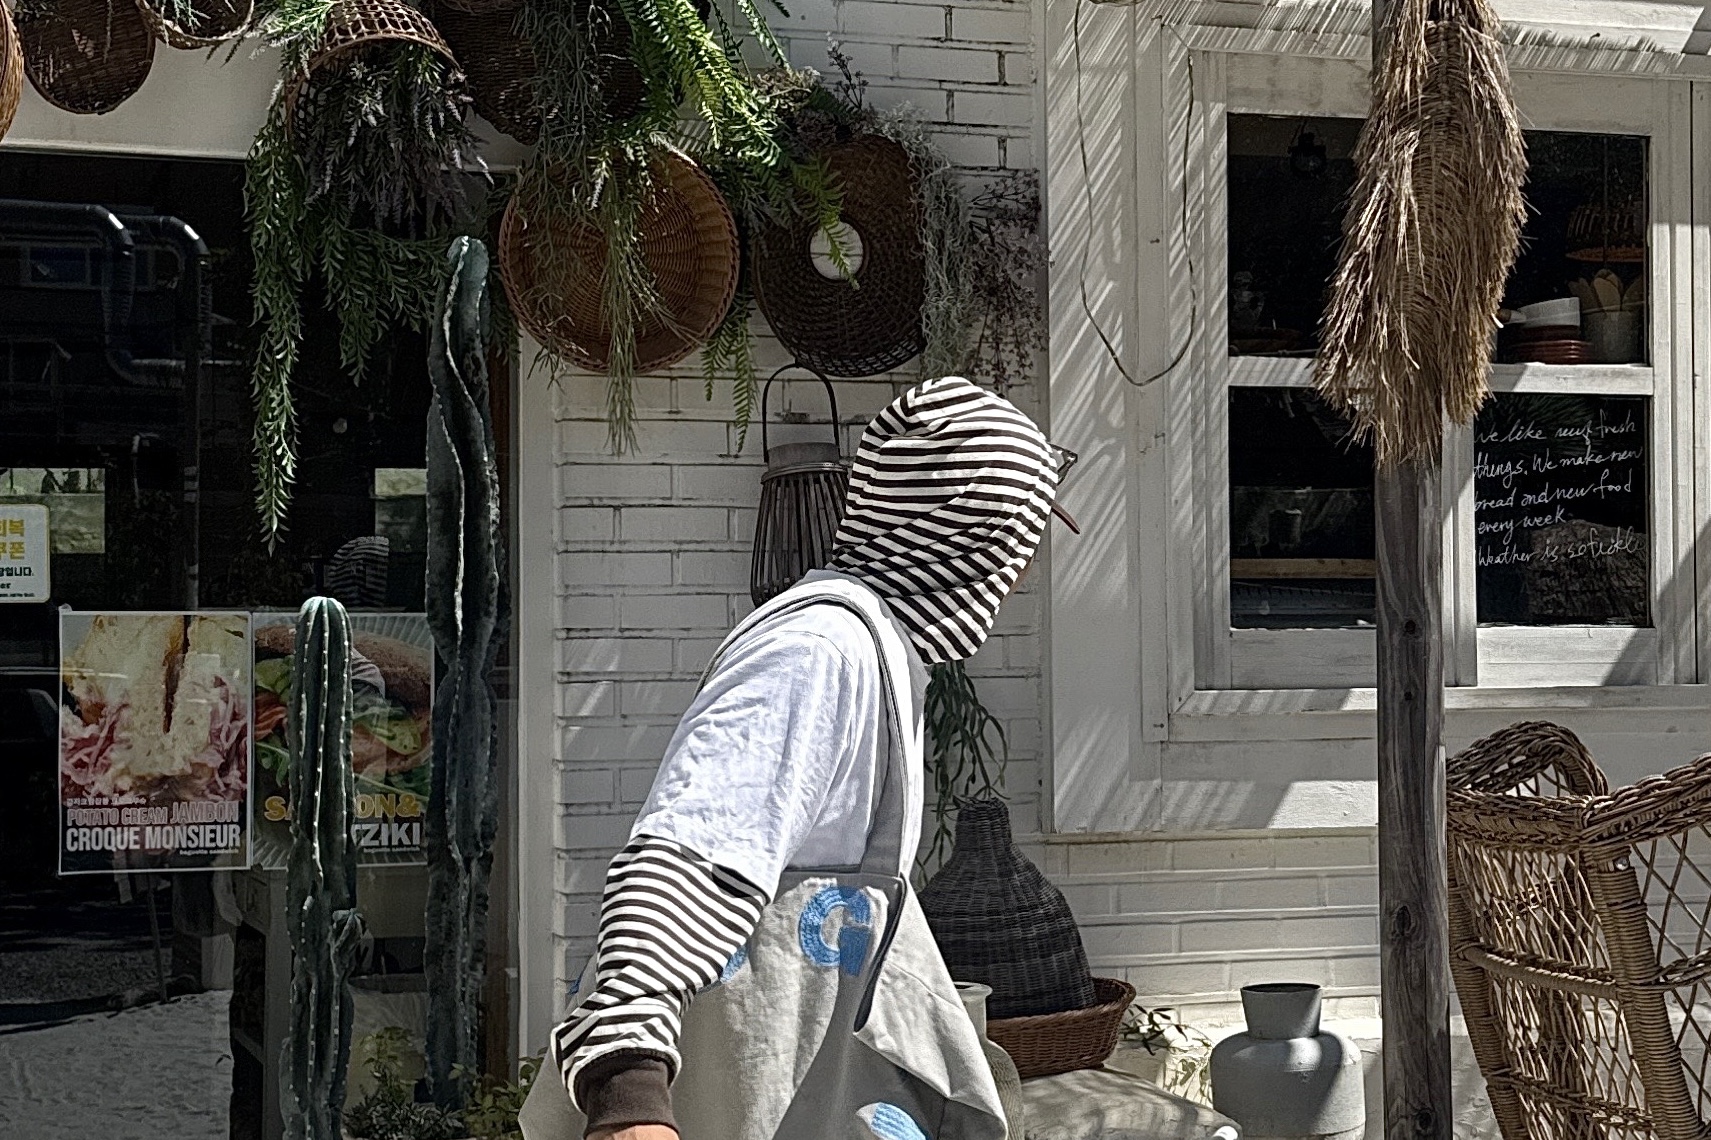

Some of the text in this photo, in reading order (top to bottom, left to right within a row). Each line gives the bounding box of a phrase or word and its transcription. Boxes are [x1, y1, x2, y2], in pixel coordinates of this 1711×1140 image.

[1500, 419, 1547, 442] like
[1595, 408, 1637, 439] fresh
[1533, 447, 1558, 473] We
[1560, 444, 1606, 466] make
[1474, 468, 1632, 512] bread and new food
[1478, 519, 1514, 545] every
[1478, 543, 1538, 567] Weather
[1540, 539, 1559, 562] is
[66, 807, 120, 827] POTATO
[121, 806, 169, 825] CREAM
[170, 800, 240, 825] JAMBON
[65, 823, 242, 853] CROQUE MONSIEUR
